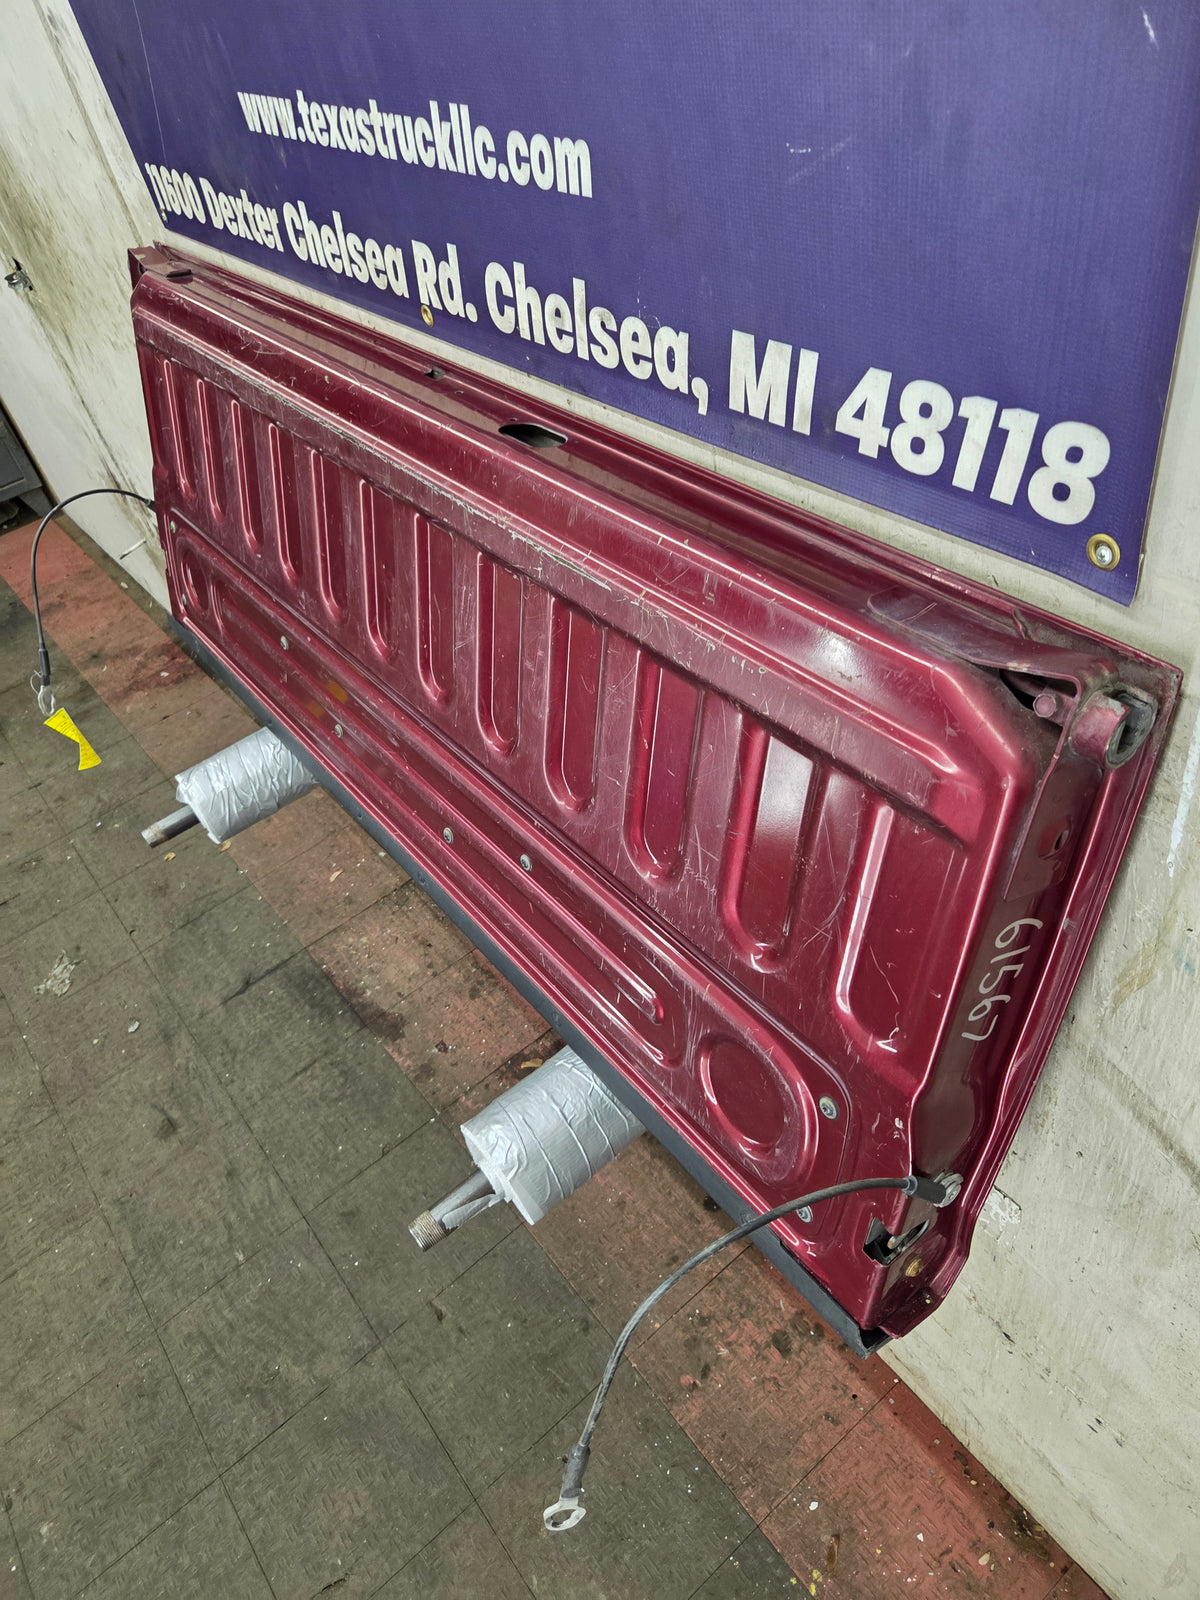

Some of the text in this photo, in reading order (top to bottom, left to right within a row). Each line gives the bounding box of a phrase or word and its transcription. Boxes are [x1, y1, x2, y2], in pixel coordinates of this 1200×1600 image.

[237, 89, 593, 198] www.texastruckllc.com
[145, 162, 1111, 525] 11600 Dexter Chelsea Rd. Chelsea, MI 48118
[961, 917, 1044, 1041] 61567
